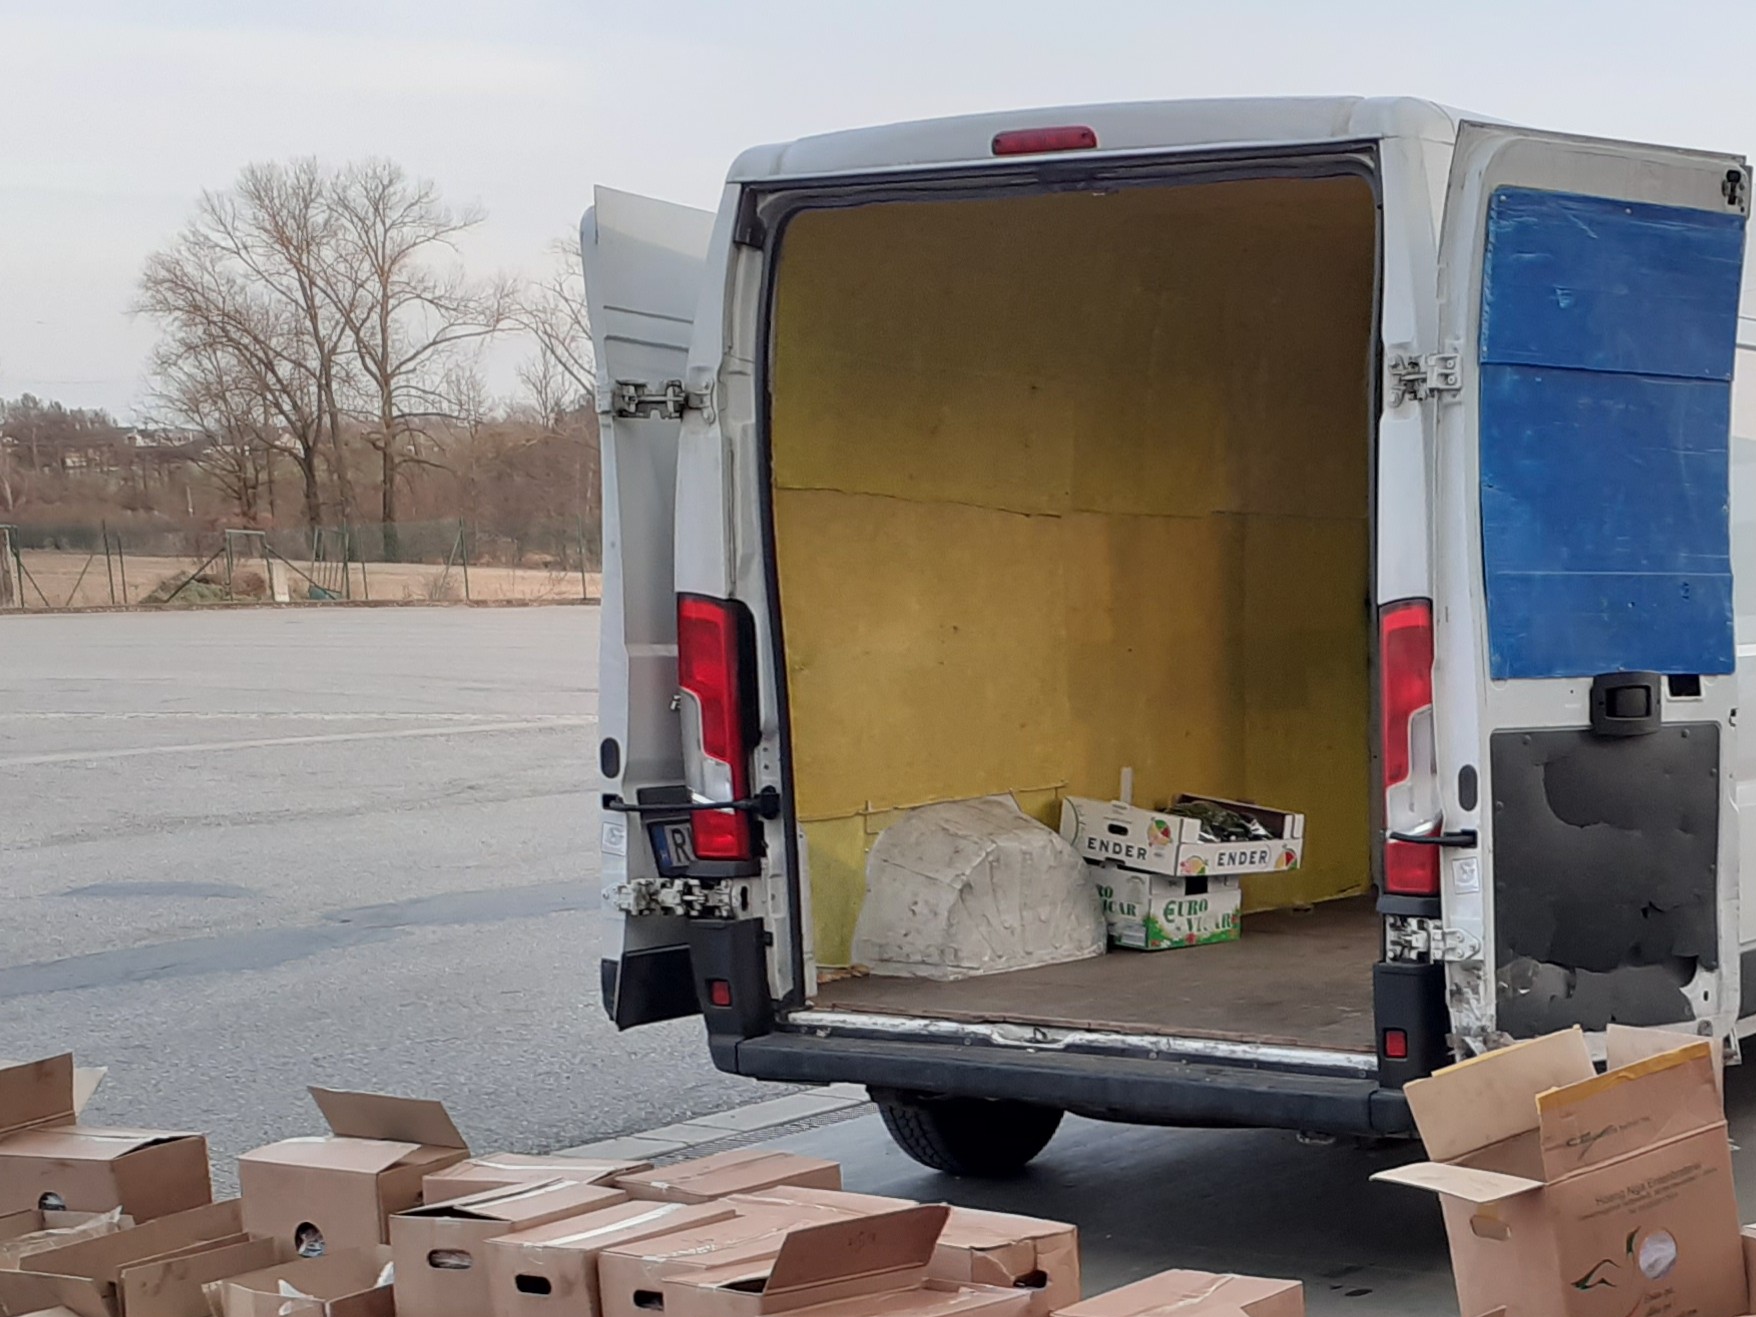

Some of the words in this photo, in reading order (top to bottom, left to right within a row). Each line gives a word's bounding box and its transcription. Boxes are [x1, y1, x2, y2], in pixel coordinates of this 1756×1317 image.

[671, 827, 693, 863] R
[1087, 836, 1147, 861] ENDER
[1216, 849, 1268, 866] ENDER
